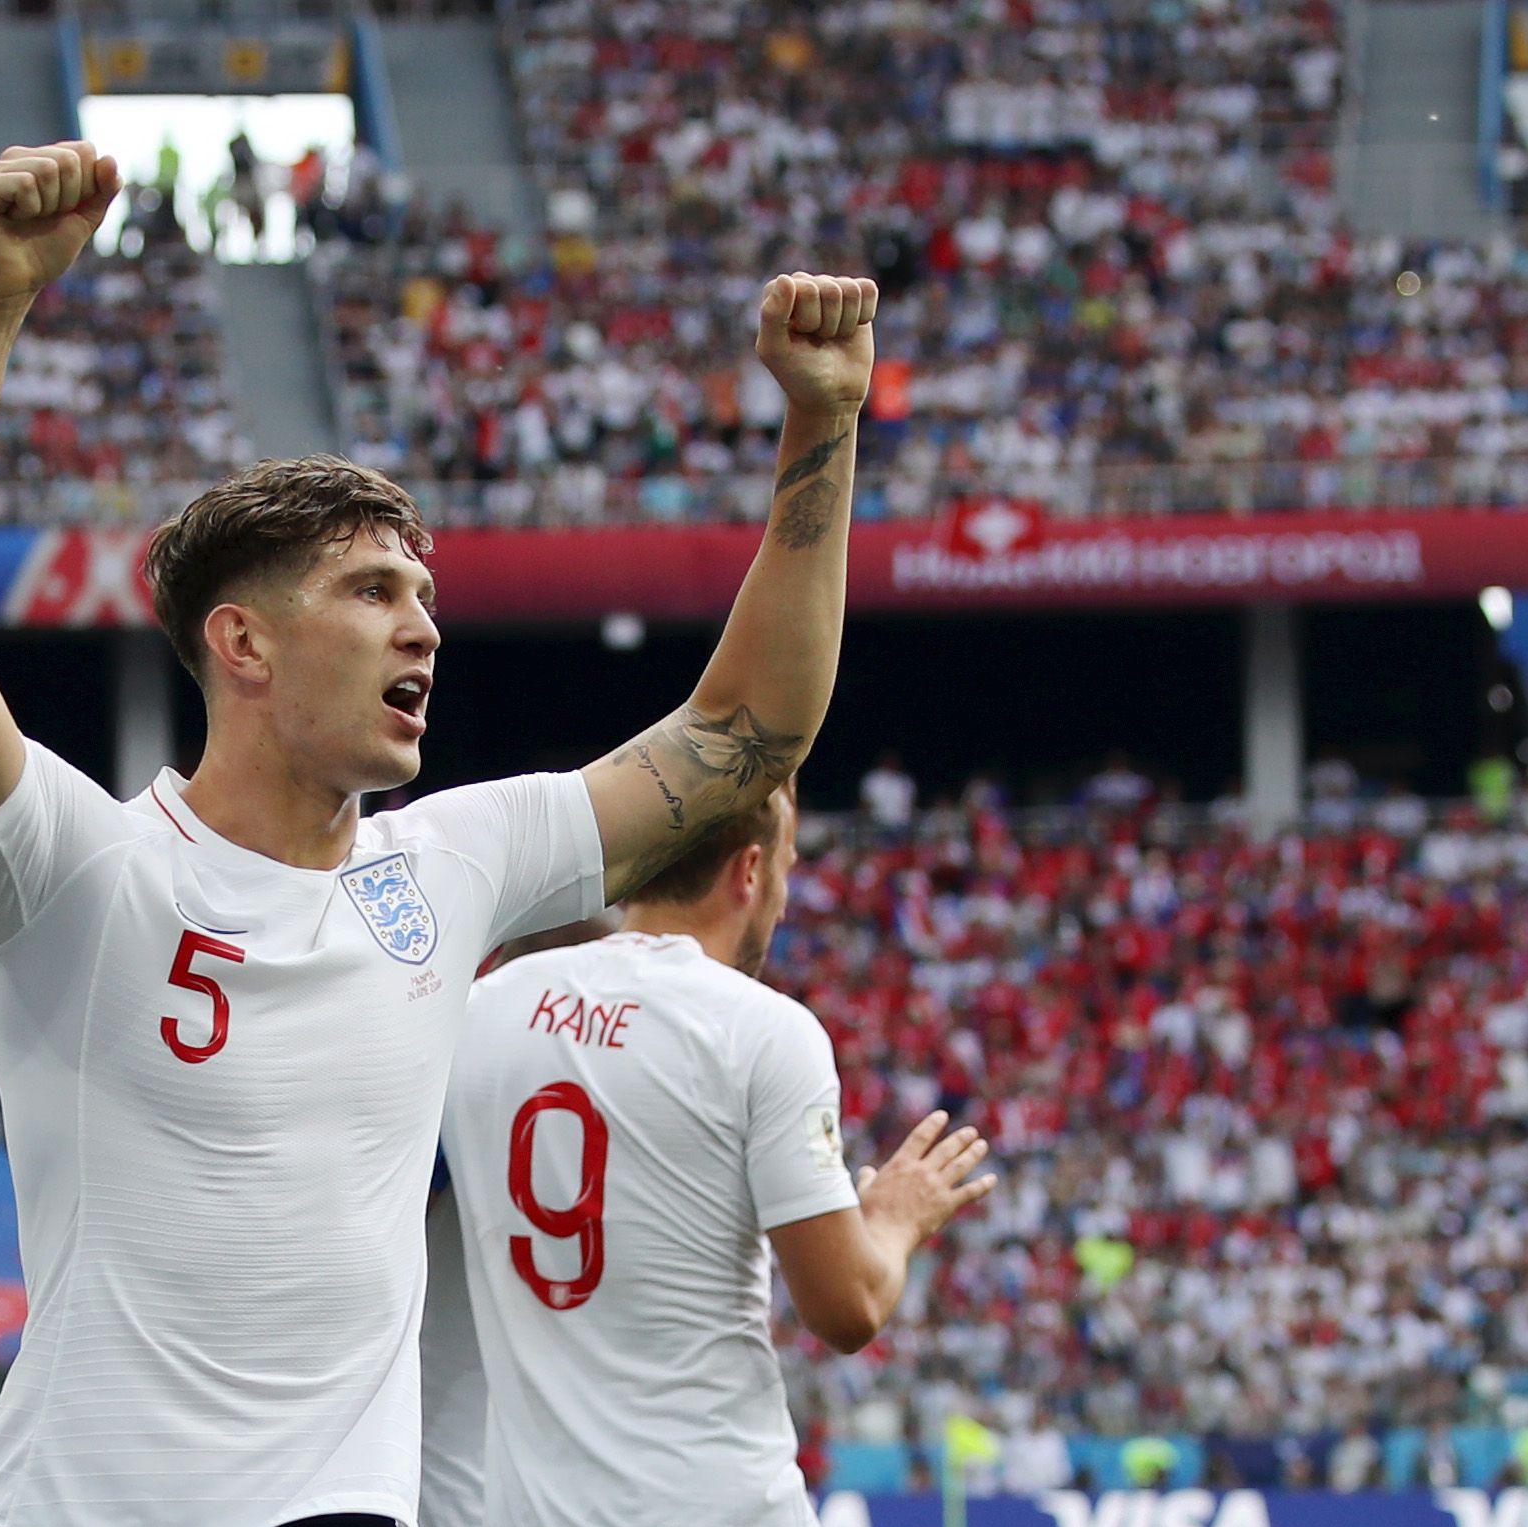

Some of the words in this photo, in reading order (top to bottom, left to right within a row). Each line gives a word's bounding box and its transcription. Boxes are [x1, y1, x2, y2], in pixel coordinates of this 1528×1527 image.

[160, 929, 246, 1064] 5
[529, 989, 640, 1049] KANE
[508, 1081, 609, 1311] 9
